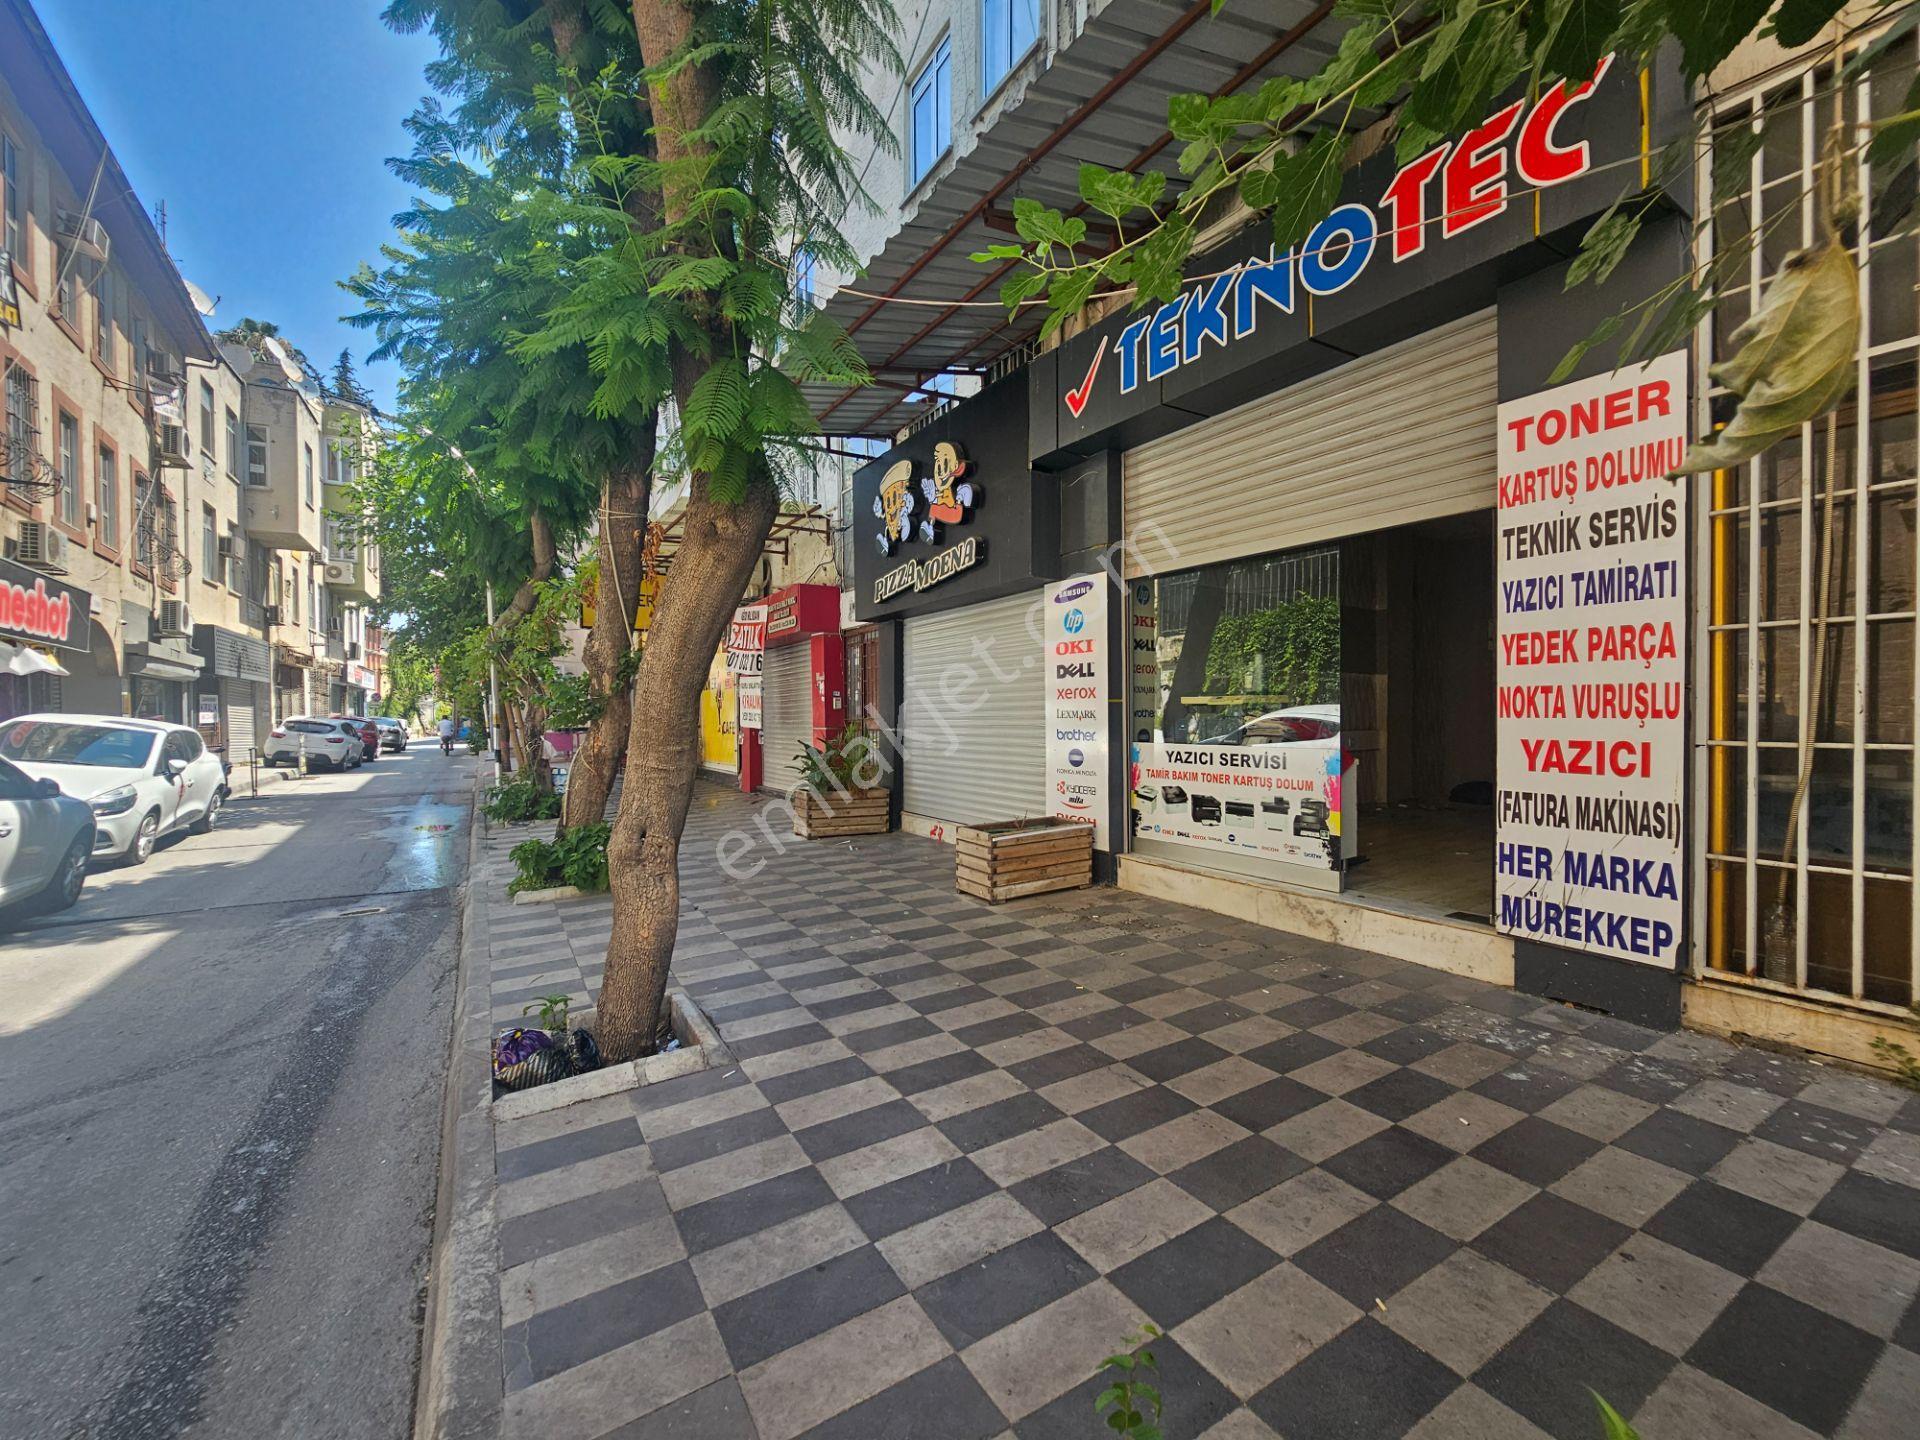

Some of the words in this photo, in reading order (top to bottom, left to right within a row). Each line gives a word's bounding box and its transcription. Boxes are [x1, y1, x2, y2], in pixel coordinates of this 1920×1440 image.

[1114, 52, 1615, 395] TEKNOTEC
[1508, 379, 1671, 452] TONER
[1499, 460, 1578, 509] KARTUŞ
[1585, 436, 1683, 492] DOLUMU
[1503, 510, 1582, 561] TEKNİK
[1589, 493, 1677, 549] SERVİS
[874, 559, 917, 603] PIZZA
[914, 537, 976, 593] MOENA
[1503, 574, 1564, 613] YAZICI
[1571, 558, 1677, 607] TAMİRATI
[1064, 608, 1084, 633] hp
[1056, 639, 1095, 655] OKI
[1502, 628, 1579, 665] YEDEK
[1587, 621, 1677, 669] PARÇA
[1056, 662, 1095, 679] DELL
[1056, 686, 1097, 700] xerox
[1056, 708, 1097, 721] LEXMARK
[1499, 684, 1567, 719] NOKTA
[1572, 682, 1681, 728] VURUŞLU
[1056, 728, 1097, 742] brother
[1520, 739, 1652, 778] YAZICI
[1146, 767, 1170, 779] TAMİR
[1172, 770, 1198, 782] BAKIM
[1201, 772, 1230, 785] TONER
[1233, 775, 1273, 792] KARTUŞ
[1276, 777, 1314, 792] DOLUM
[1166, 750, 1214, 766] YAZICI
[1219, 751, 1288, 770] SERVİSİ
[1498, 790, 1569, 829] (FATURA
[1576, 790, 1681, 849] MAKİNASI)
[1499, 842, 1552, 881] HER
[1564, 850, 1678, 901] MARKA
[1502, 891, 1673, 957] MÜREKKEP
